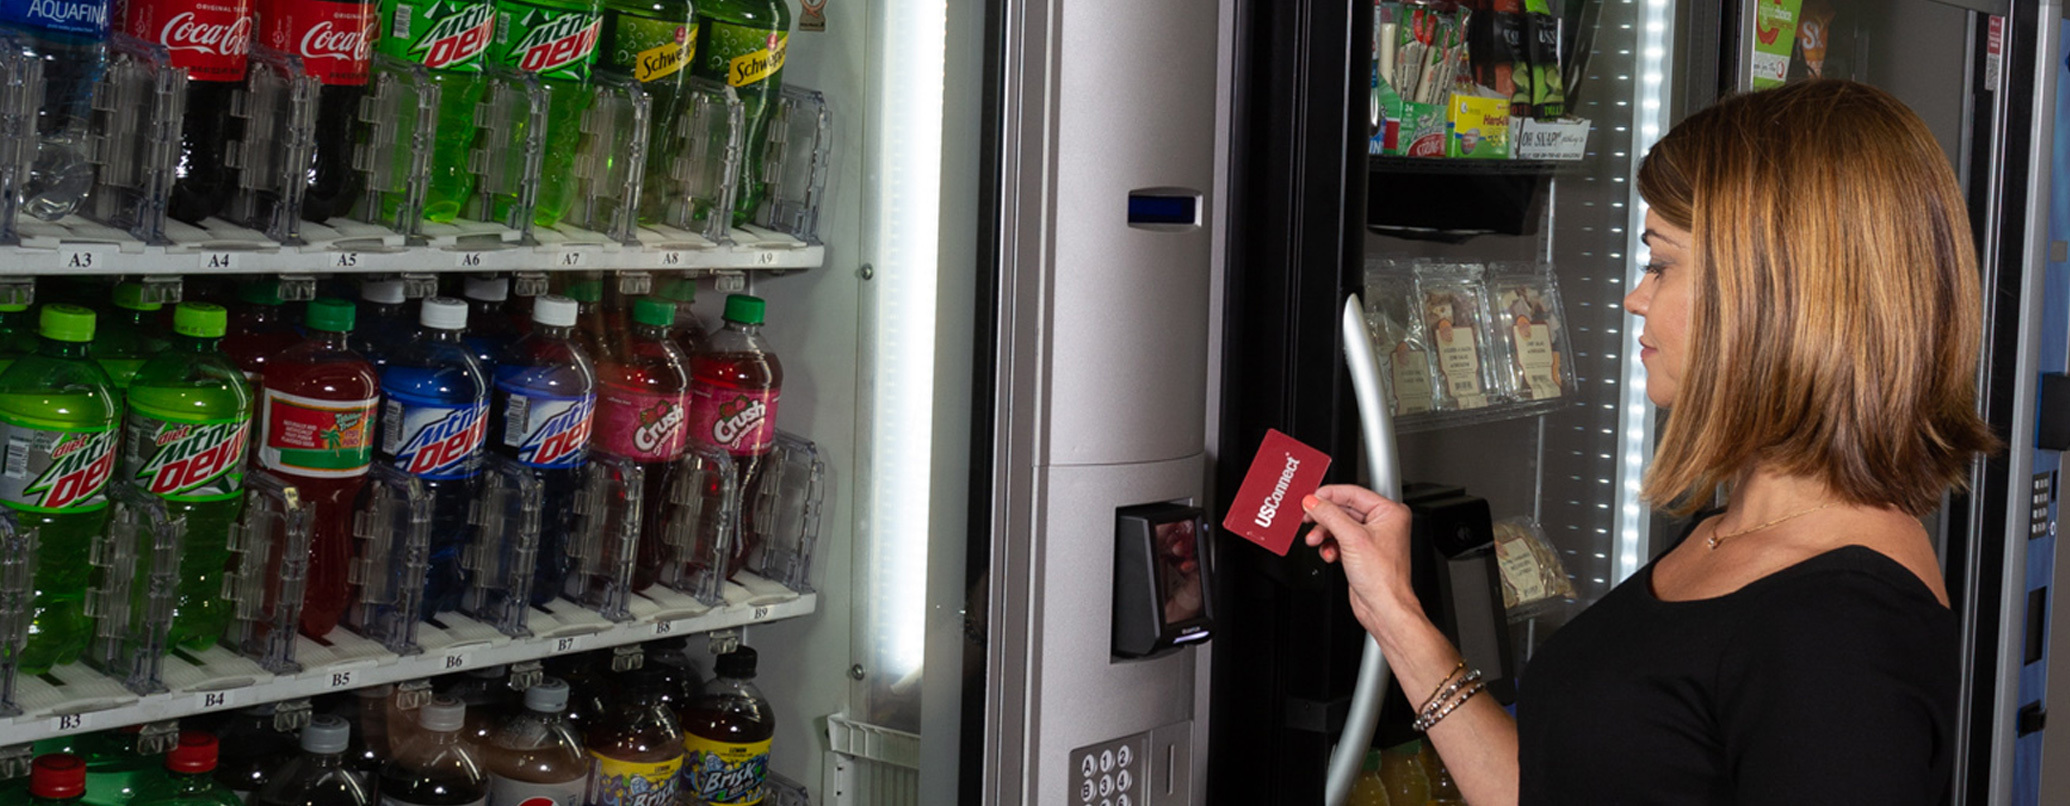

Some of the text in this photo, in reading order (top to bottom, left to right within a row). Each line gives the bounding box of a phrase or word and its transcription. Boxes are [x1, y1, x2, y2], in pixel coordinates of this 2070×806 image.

[27, 0, 109, 26] AQUAFINA
[68, 252, 92, 268] A3
[208, 253, 229, 268] A4
[337, 253, 357, 267] A5
[462, 253, 481, 267] A6
[562, 252, 579, 266] A7
[663, 252, 680, 265] A8
[758, 252, 773, 265] A9
[635, 404, 684, 451] Crush
[713, 399, 767, 443] Crush
[156, 425, 191, 446] diet
[52, 434, 90, 459] diet
[150, 423, 229, 469] Mtn
[754, 607, 769, 619] B9
[656, 621, 672, 634] B8
[558, 637, 574, 652] B7
[446, 654, 463, 669] B6
[332, 671, 350, 687] B5
[205, 692, 225, 708] B4
[59, 713, 81, 730] B3
[1083, 759, 1092, 774] A
[1120, 750, 1126, 765] 2
[703, 762, 756, 794] Brisk
[1083, 774, 1124, 798] B 3 4
